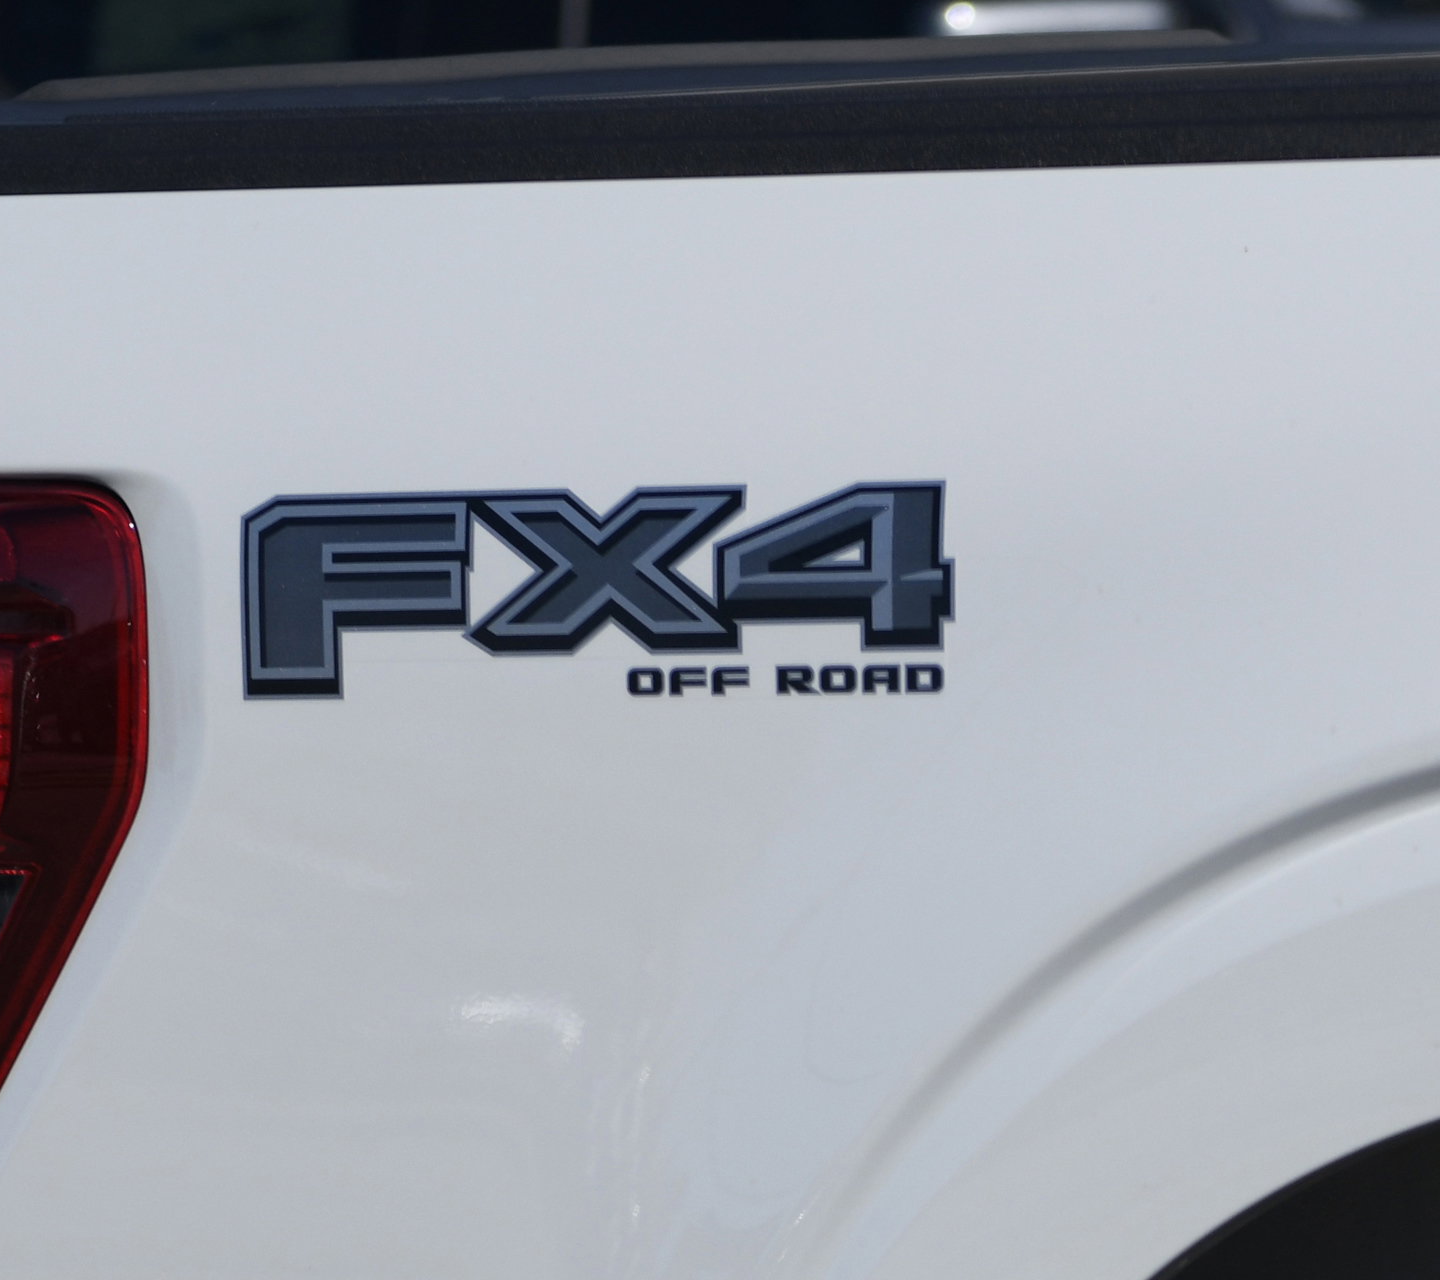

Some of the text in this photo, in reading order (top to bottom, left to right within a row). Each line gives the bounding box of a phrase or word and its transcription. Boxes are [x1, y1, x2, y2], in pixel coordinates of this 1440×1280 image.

[241, 480, 955, 699] FX4
[627, 664, 945, 696] OFF ROAD
